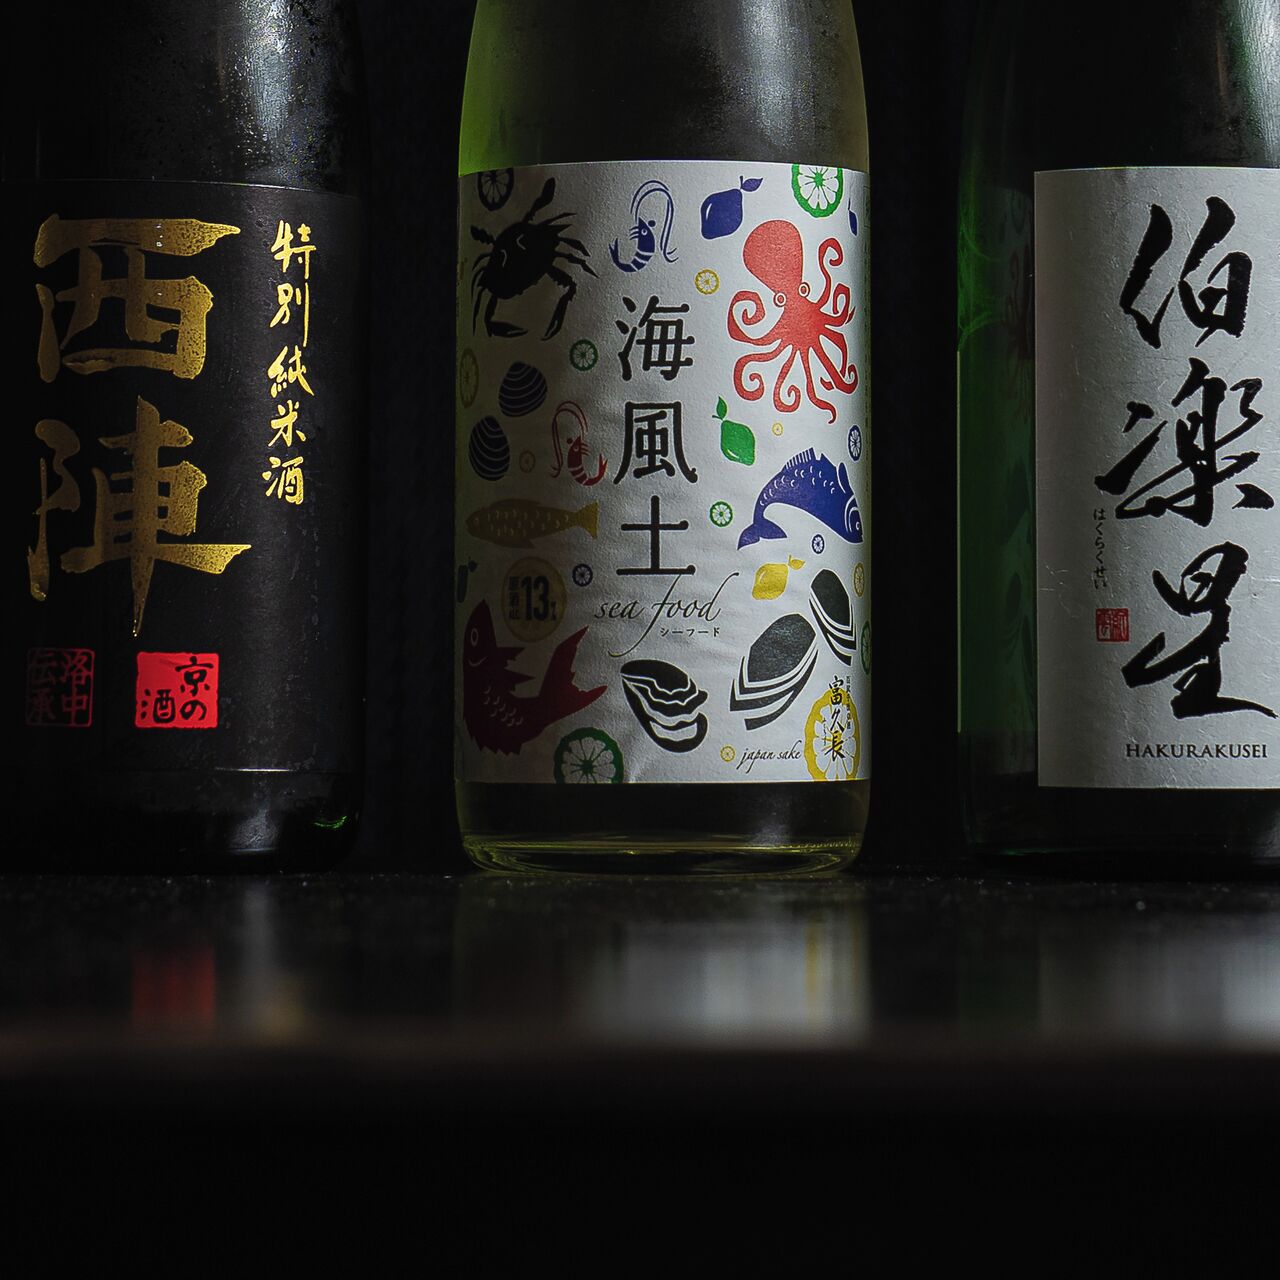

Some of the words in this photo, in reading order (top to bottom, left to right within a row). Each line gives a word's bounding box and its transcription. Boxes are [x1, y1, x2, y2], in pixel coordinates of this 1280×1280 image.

[263, 220, 318, 505] 特別純米酒
[26, 212, 252, 638] 西陣
[614, 294, 698, 576] 海風土
[1094, 196, 1278, 720] 伯楽星
[1093, 507, 1108, 590] はくらくせい
[594, 599, 646, 619] sea
[607, 570, 740, 658] food
[659, 626, 721, 638] シーフード
[736, 747, 776, 775] japan
[777, 739, 802, 761] sake
[824, 675, 847, 762] 富久長
[1125, 742, 1268, 759] HAKURAKUSEI
